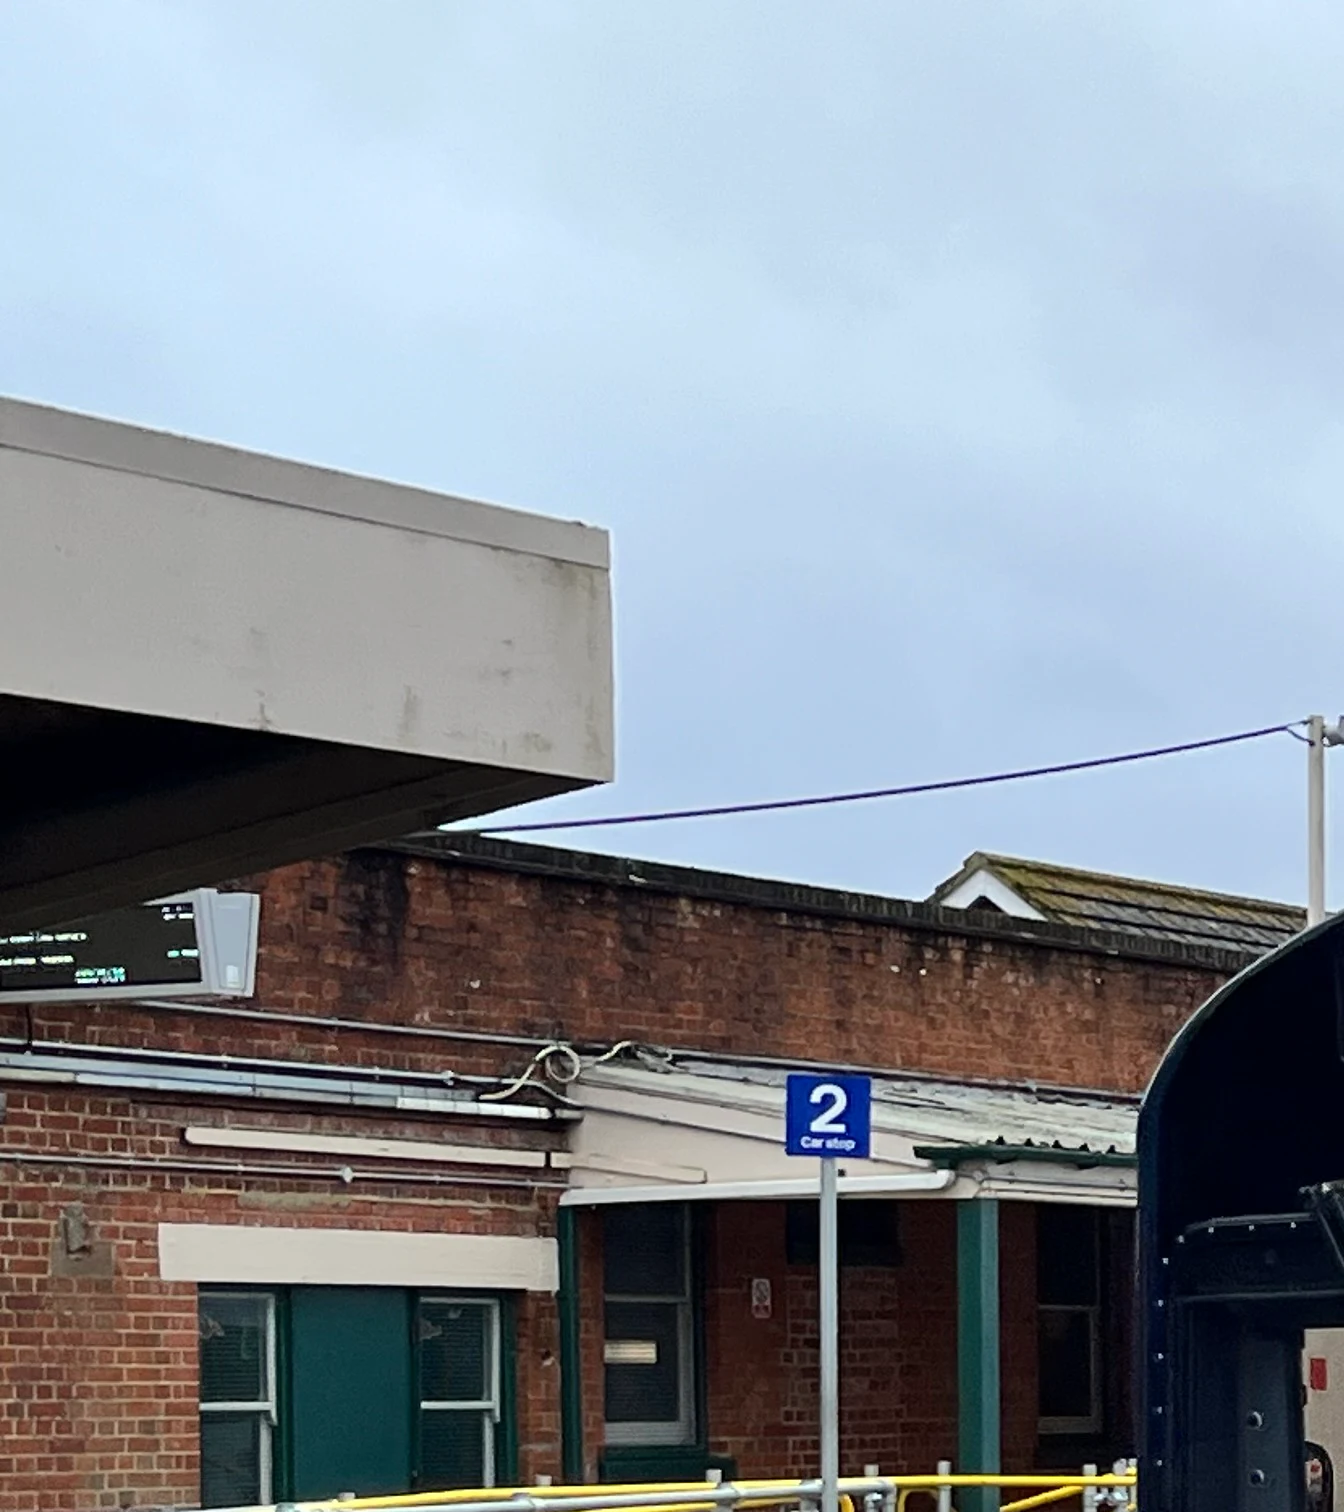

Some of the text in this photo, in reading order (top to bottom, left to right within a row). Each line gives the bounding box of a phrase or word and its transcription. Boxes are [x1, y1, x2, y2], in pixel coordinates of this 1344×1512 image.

[810, 1083, 847, 1133] 2
[800, 1135, 856, 1152] Car stop
